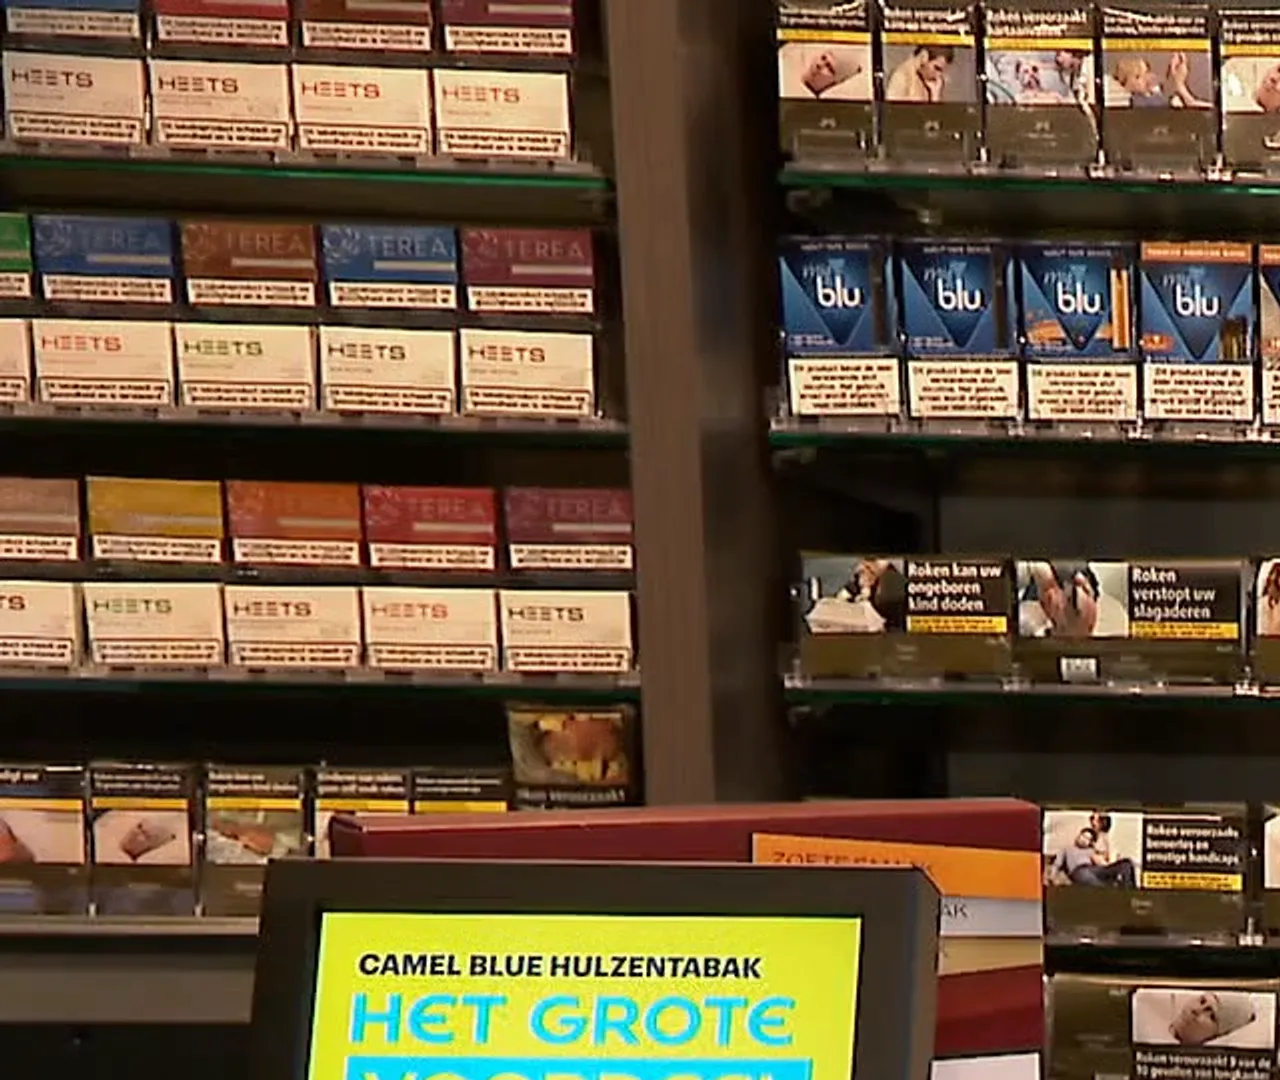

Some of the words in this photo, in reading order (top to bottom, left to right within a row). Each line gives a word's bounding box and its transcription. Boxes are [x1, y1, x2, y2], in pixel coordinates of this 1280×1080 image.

[11, 69, 93, 88] HEETS
[158, 74, 238, 94] HEETS
[301, 81, 380, 99] HEETS
[442, 85, 519, 103] HEETS
[367, 235, 448, 258] TEREA
[817, 277, 861, 309] blu
[937, 278, 982, 311] blu
[1057, 282, 1101, 315] blu
[1176, 285, 1219, 317] blu
[41, 335, 122, 352] HEETS
[183, 339, 263, 356] HEETS
[328, 343, 406, 361] HEETS
[468, 345, 545, 363] HEETS
[908, 562, 949, 577] Roken
[953, 563, 976, 577] kan
[979, 565, 1000, 578] uw
[1132, 567, 1175, 584] Roken
[908, 581, 980, 597] ongeboren
[1132, 587, 1190, 603] verstopt
[1194, 588, 1215, 602] uw
[93, 598, 172, 615] HEETS
[234, 601, 311, 618] HEETS
[371, 602, 449, 619] HEETS
[909, 597, 937, 612] kind
[941, 597, 983, 612] doden
[1133, 603, 1210, 620] slagaderen
[508, 606, 583, 622] HEETS
[359, 954, 461, 977] CAMEL
[469, 955, 542, 977] BLUE
[550, 956, 761, 979] HULZENTABAK
[349, 993, 507, 1044] HET
[529, 994, 796, 1047] GROTE
